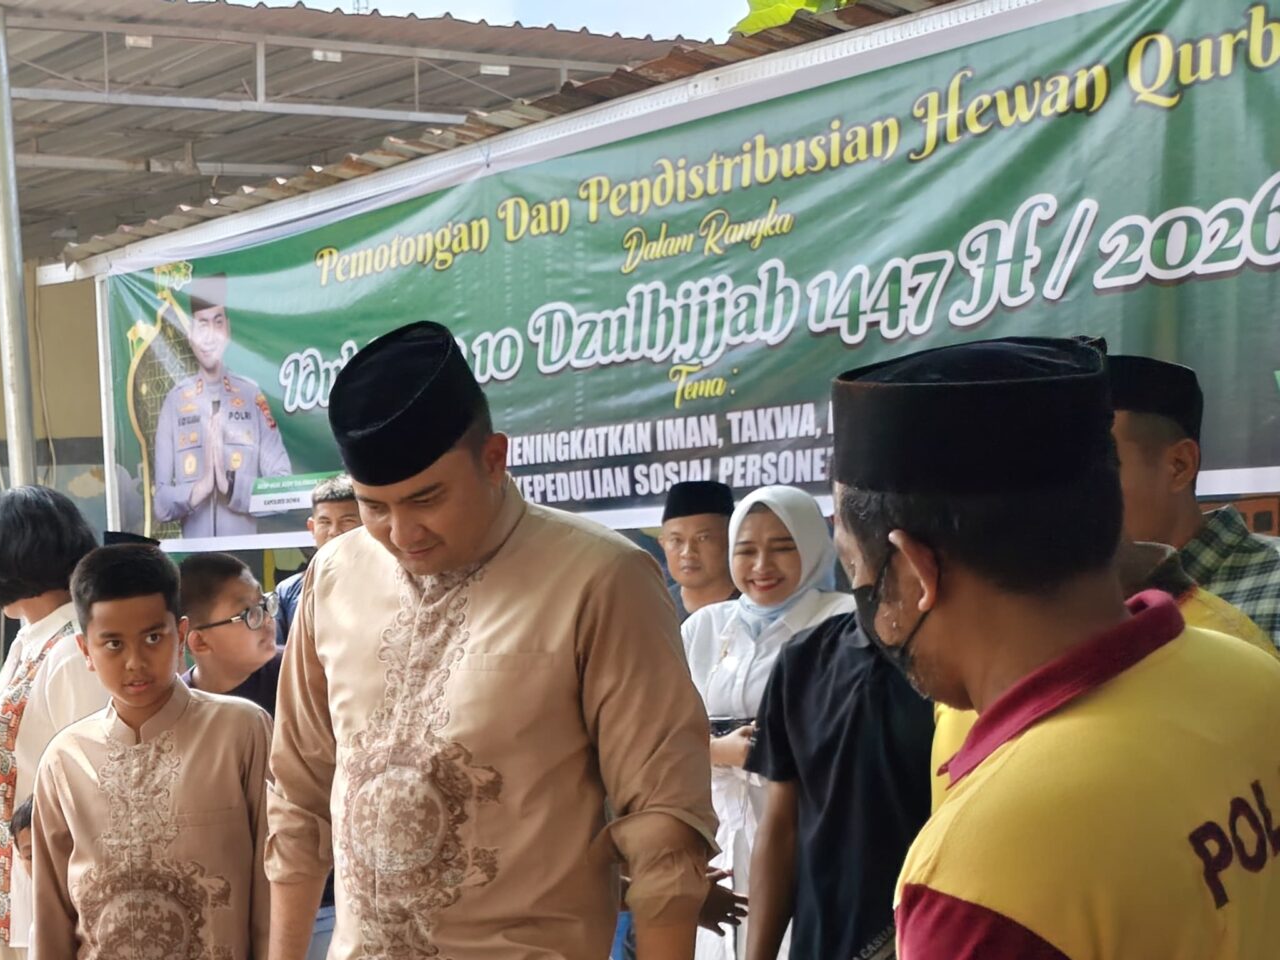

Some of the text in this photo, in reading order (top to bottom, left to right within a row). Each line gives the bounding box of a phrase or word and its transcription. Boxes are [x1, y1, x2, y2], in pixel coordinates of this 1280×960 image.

[315, 216, 490, 286] Pemotongan
[496, 195, 570, 242] Dan
[578, 118, 900, 223] Pendistribusian
[908, 68, 1109, 161] Hewan
[620, 198, 795, 275] Dalam Rangka
[279, 339, 357, 412] Idu
[472, 327, 523, 383] 10
[528, 258, 800, 373] Dzulhijjah
[668, 363, 727, 409] Tema
[656, 414, 724, 454] IMAN,
[726, 402, 822, 444] TAKWA,
[718, 446, 835, 488] PERSONE
